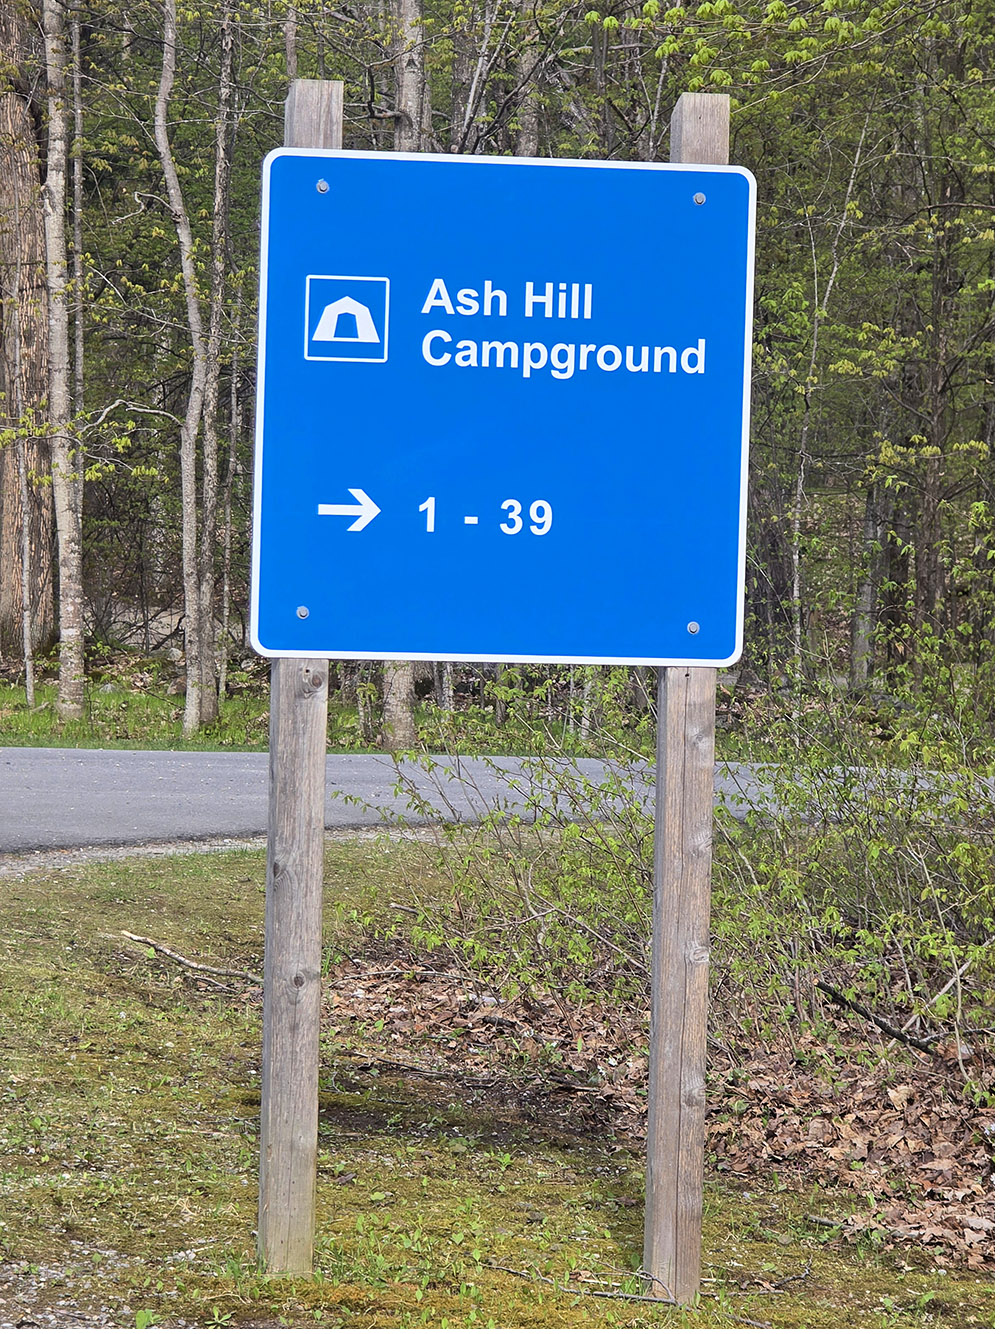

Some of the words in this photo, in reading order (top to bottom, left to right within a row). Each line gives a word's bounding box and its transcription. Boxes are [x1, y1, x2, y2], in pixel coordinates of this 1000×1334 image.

[421, 278, 508, 316] Ash
[524, 281, 593, 319] Hill
[420, 330, 706, 379] Campground
[418, 496, 436, 533] 1
[499, 499, 554, 536] 39
